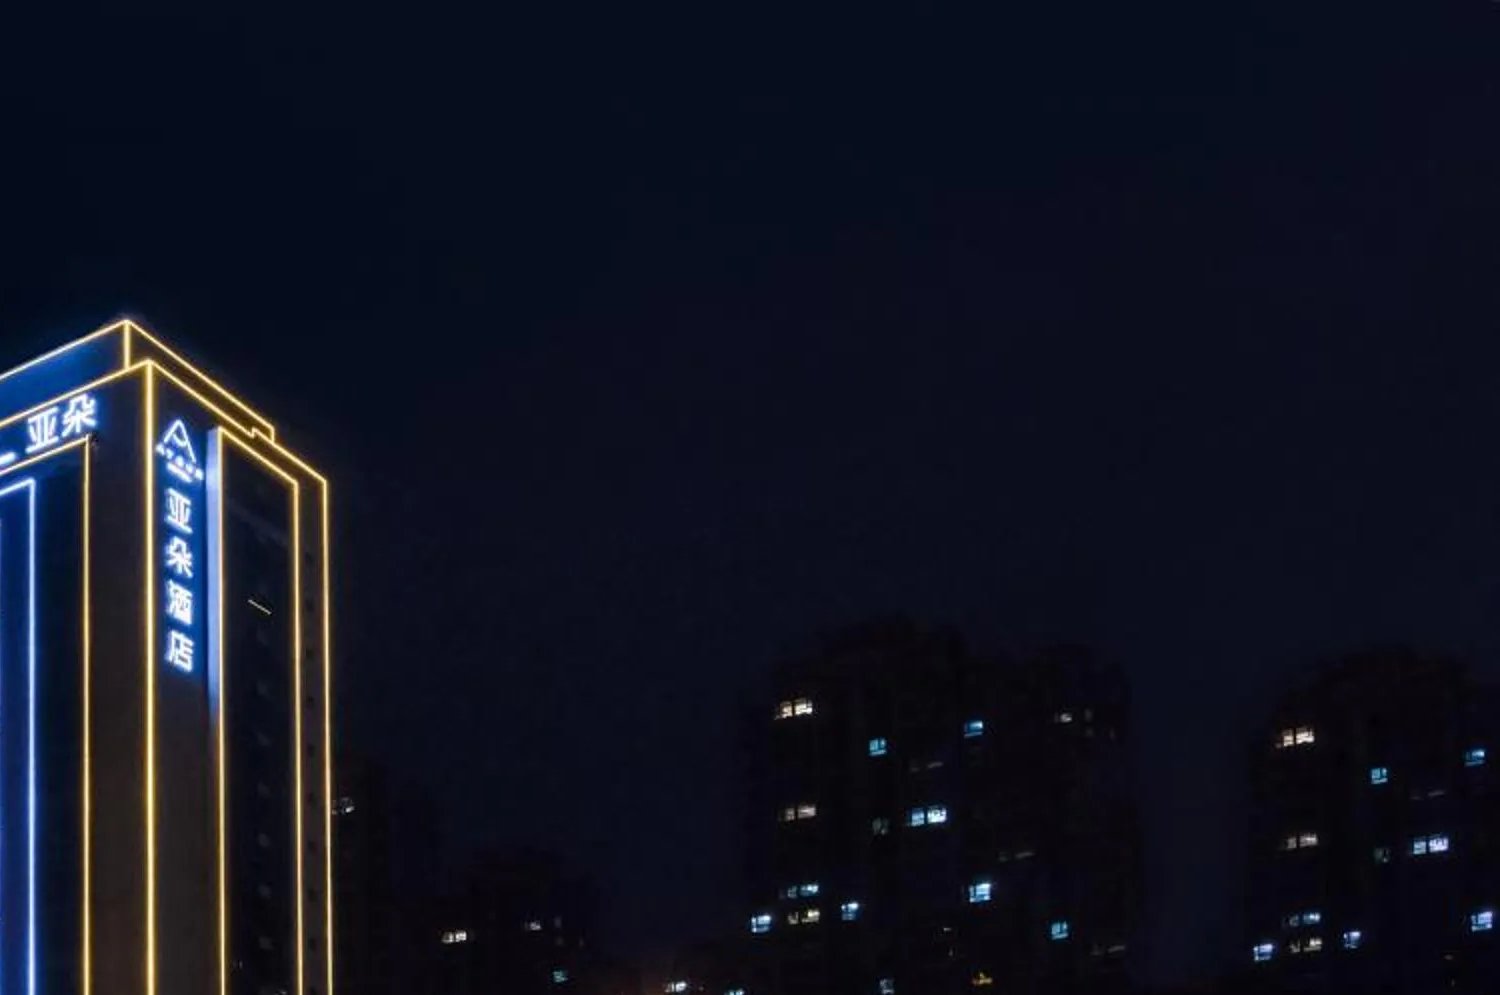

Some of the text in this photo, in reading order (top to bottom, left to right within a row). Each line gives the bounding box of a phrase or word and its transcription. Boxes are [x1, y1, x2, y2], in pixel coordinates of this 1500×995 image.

[25, 394, 97, 455] 亚朵
[164, 487, 194, 673] 亚朵酒店
